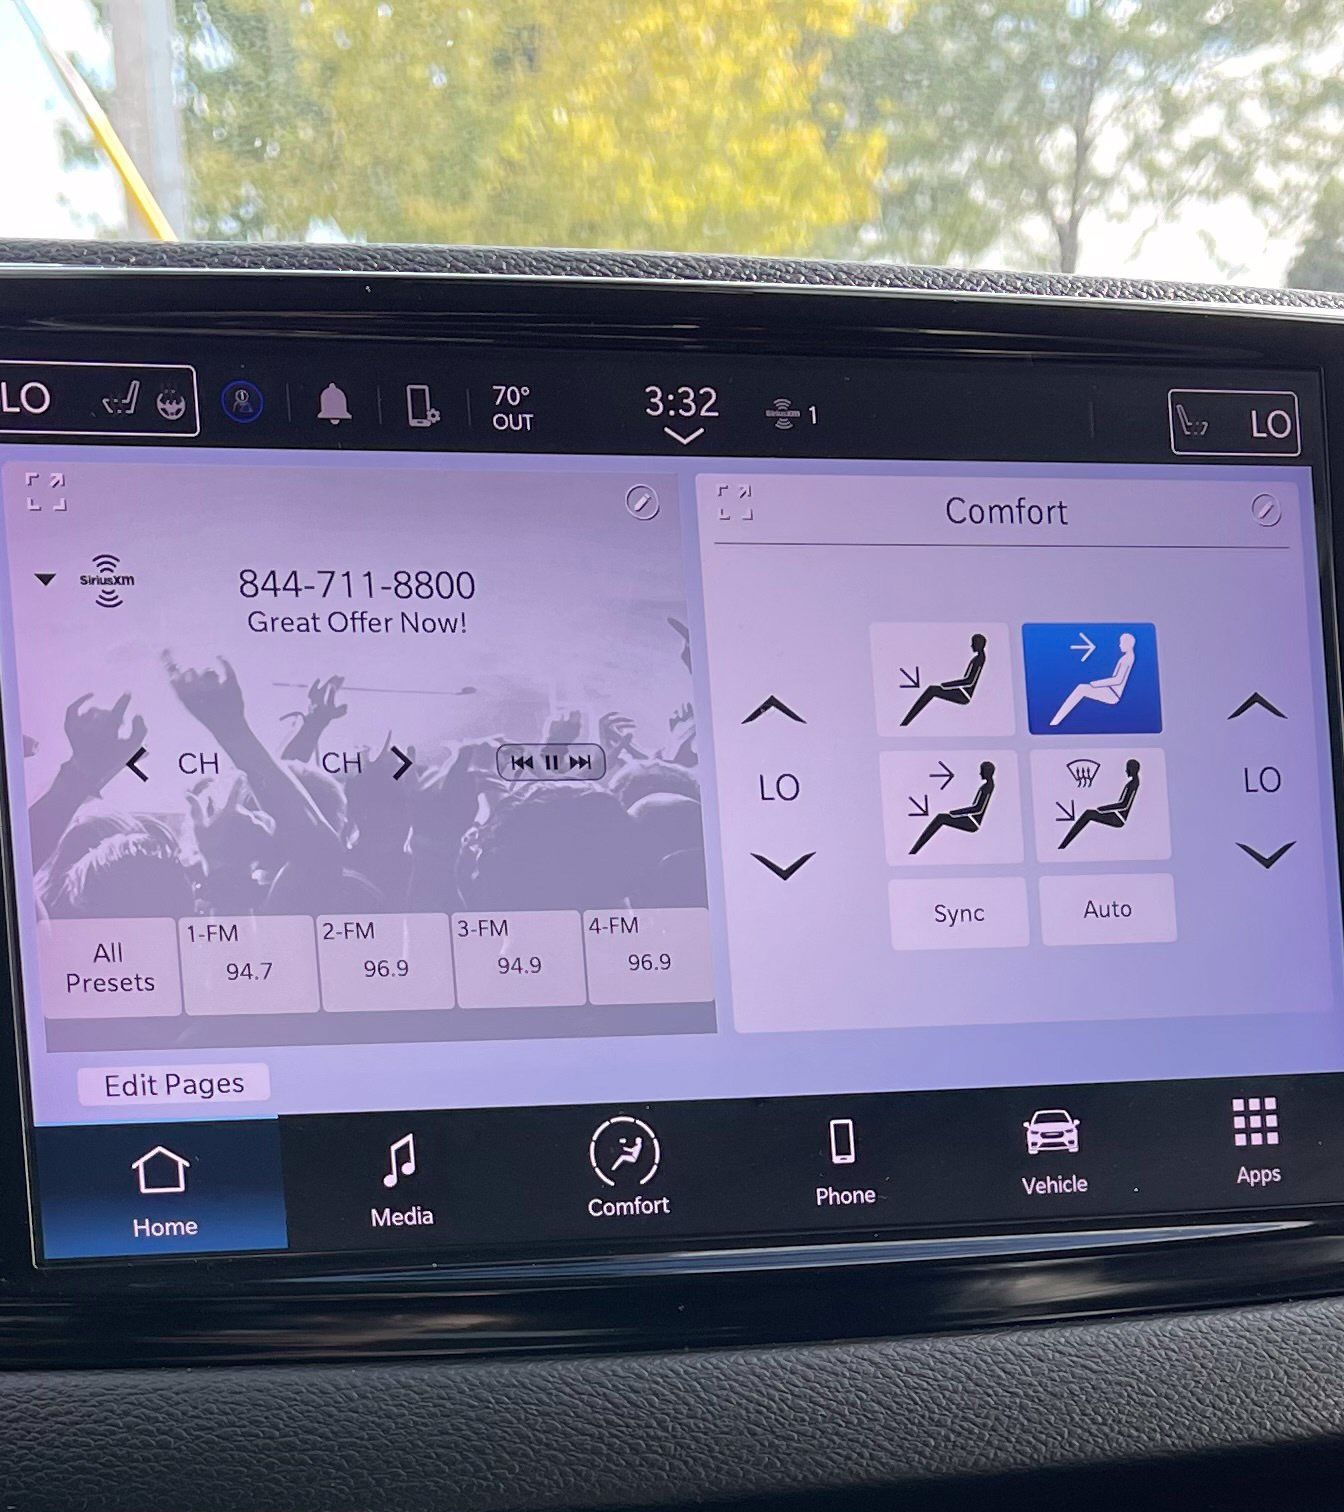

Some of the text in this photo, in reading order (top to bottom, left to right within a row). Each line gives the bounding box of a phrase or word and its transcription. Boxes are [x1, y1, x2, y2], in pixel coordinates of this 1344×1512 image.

[0, 381, 51, 414] LO
[492, 385, 530, 406] 70°
[645, 385, 719, 417] 3:32
[492, 413, 534, 431] OUT
[1251, 409, 1292, 439] LO
[946, 496, 1069, 526] Comfort
[239, 568, 476, 600] 844-711-8800
[247, 610, 467, 634] Great Offer Now!
[178, 752, 219, 775] CH
[322, 751, 363, 775] CH
[759, 773, 800, 802] LO
[1244, 766, 1282, 793] LO
[934, 903, 985, 928] Sync
[1083, 899, 1132, 919] Auto
[187, 924, 239, 943] 1-FM
[322, 921, 375, 940] 2-FM
[457, 919, 509, 938] 3-FM
[588, 916, 639, 935] 4-FM
[93, 942, 123, 963] All
[628, 953, 672, 972] 96.9
[226, 962, 273, 981] 94.7
[363, 959, 409, 978] 96.9
[497, 956, 542, 975] 94.9
[66, 972, 155, 993] Presets
[105, 1073, 245, 1100] Edit Pages
[1021, 1174, 1088, 1195] Vehicle
[1236, 1166, 1282, 1187] Apps
[587, 1195, 671, 1217] Comfort
[816, 1186, 876, 1206] Phone
[371, 1205, 434, 1227] Media
[133, 1218, 198, 1238] Home
